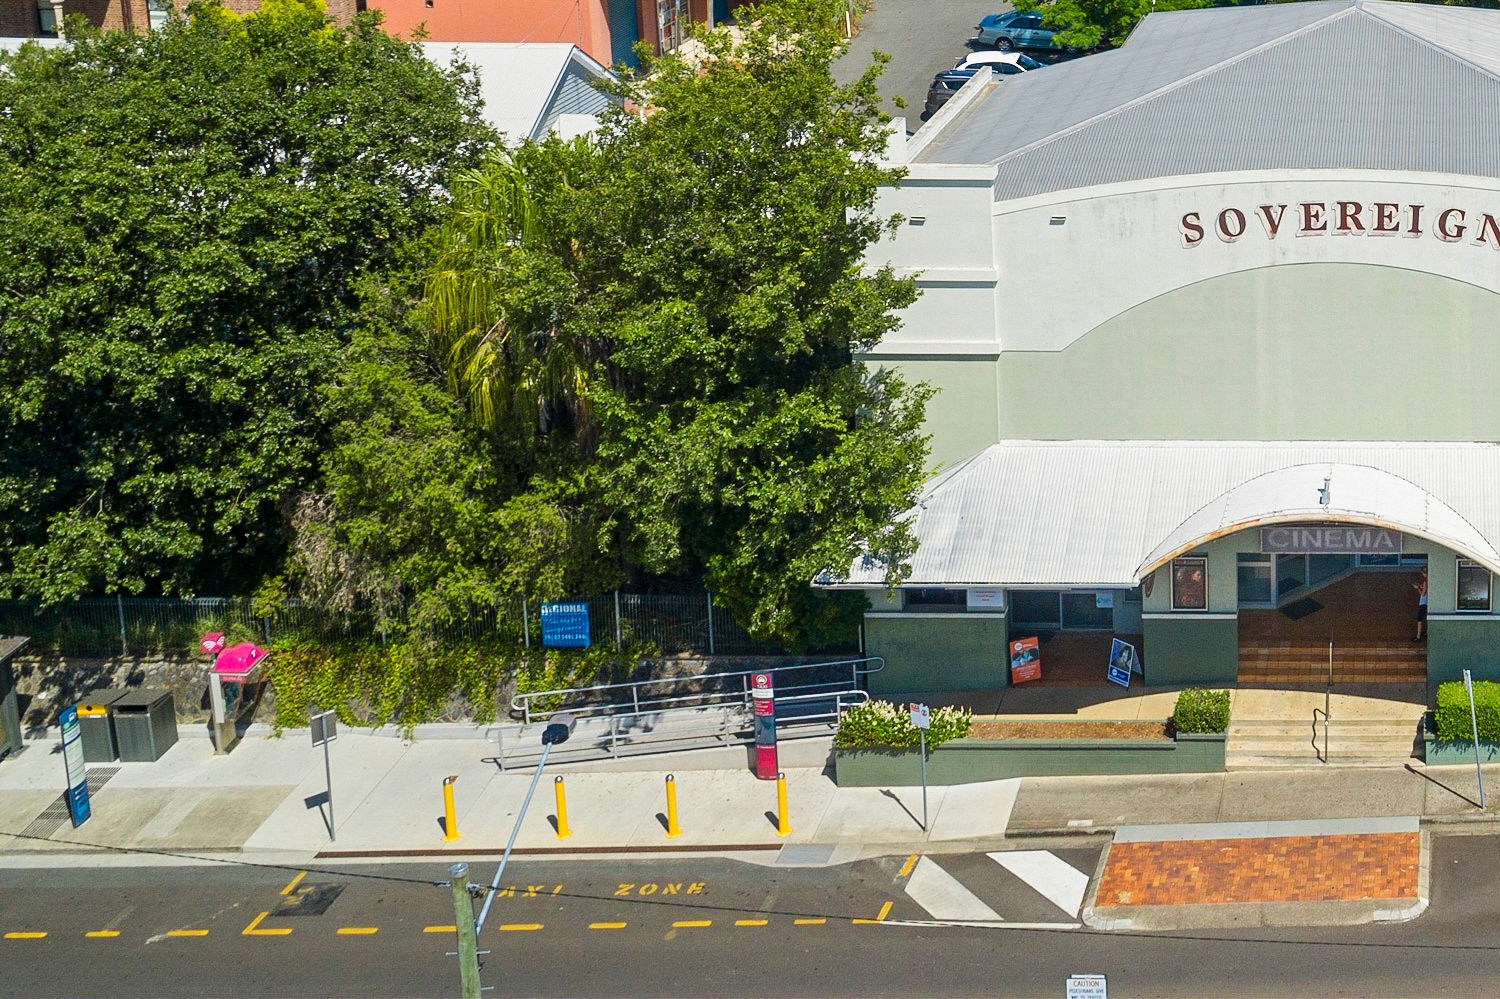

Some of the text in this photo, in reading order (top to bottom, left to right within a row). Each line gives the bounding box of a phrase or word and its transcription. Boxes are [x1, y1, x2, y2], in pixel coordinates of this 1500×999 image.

[1268, 529, 1394, 548] CINEMA
[482, 882, 706, 898] AXI ZONE
[1073, 980, 1100, 988] CAUTION
